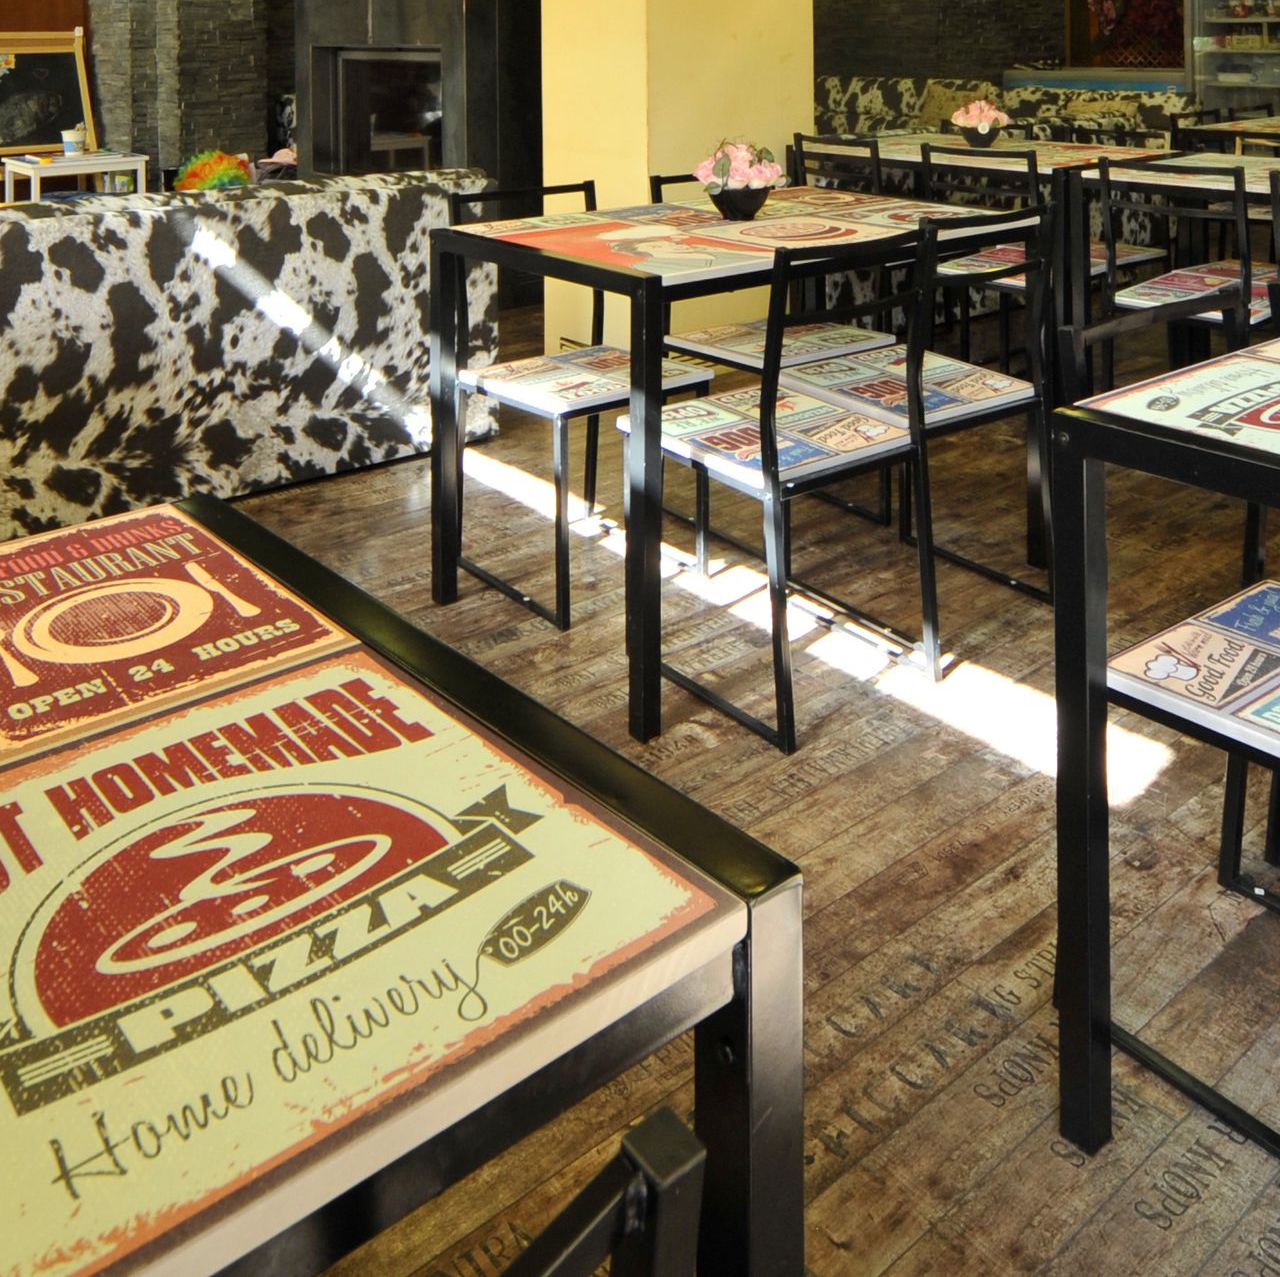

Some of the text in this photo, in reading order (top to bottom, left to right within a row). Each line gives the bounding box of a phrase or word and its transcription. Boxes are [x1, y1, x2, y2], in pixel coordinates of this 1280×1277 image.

[73, 542, 92, 560] &
[94, 519, 186, 554] DRINKS
[6, 617, 303, 721] OPEN 24 HOURS
[1184, 662, 1225, 702] Good
[1208, 637, 1247, 677] Food
[45, 676, 438, 843] HOMEMADE
[114, 871, 464, 1072] PIZZA
[48, 1067, 257, 1200] Home
[270, 952, 488, 1084] delivery
[497, 882, 581, 962] 00-24h
[1132, 1137, 1233, 1233] KNOPS
